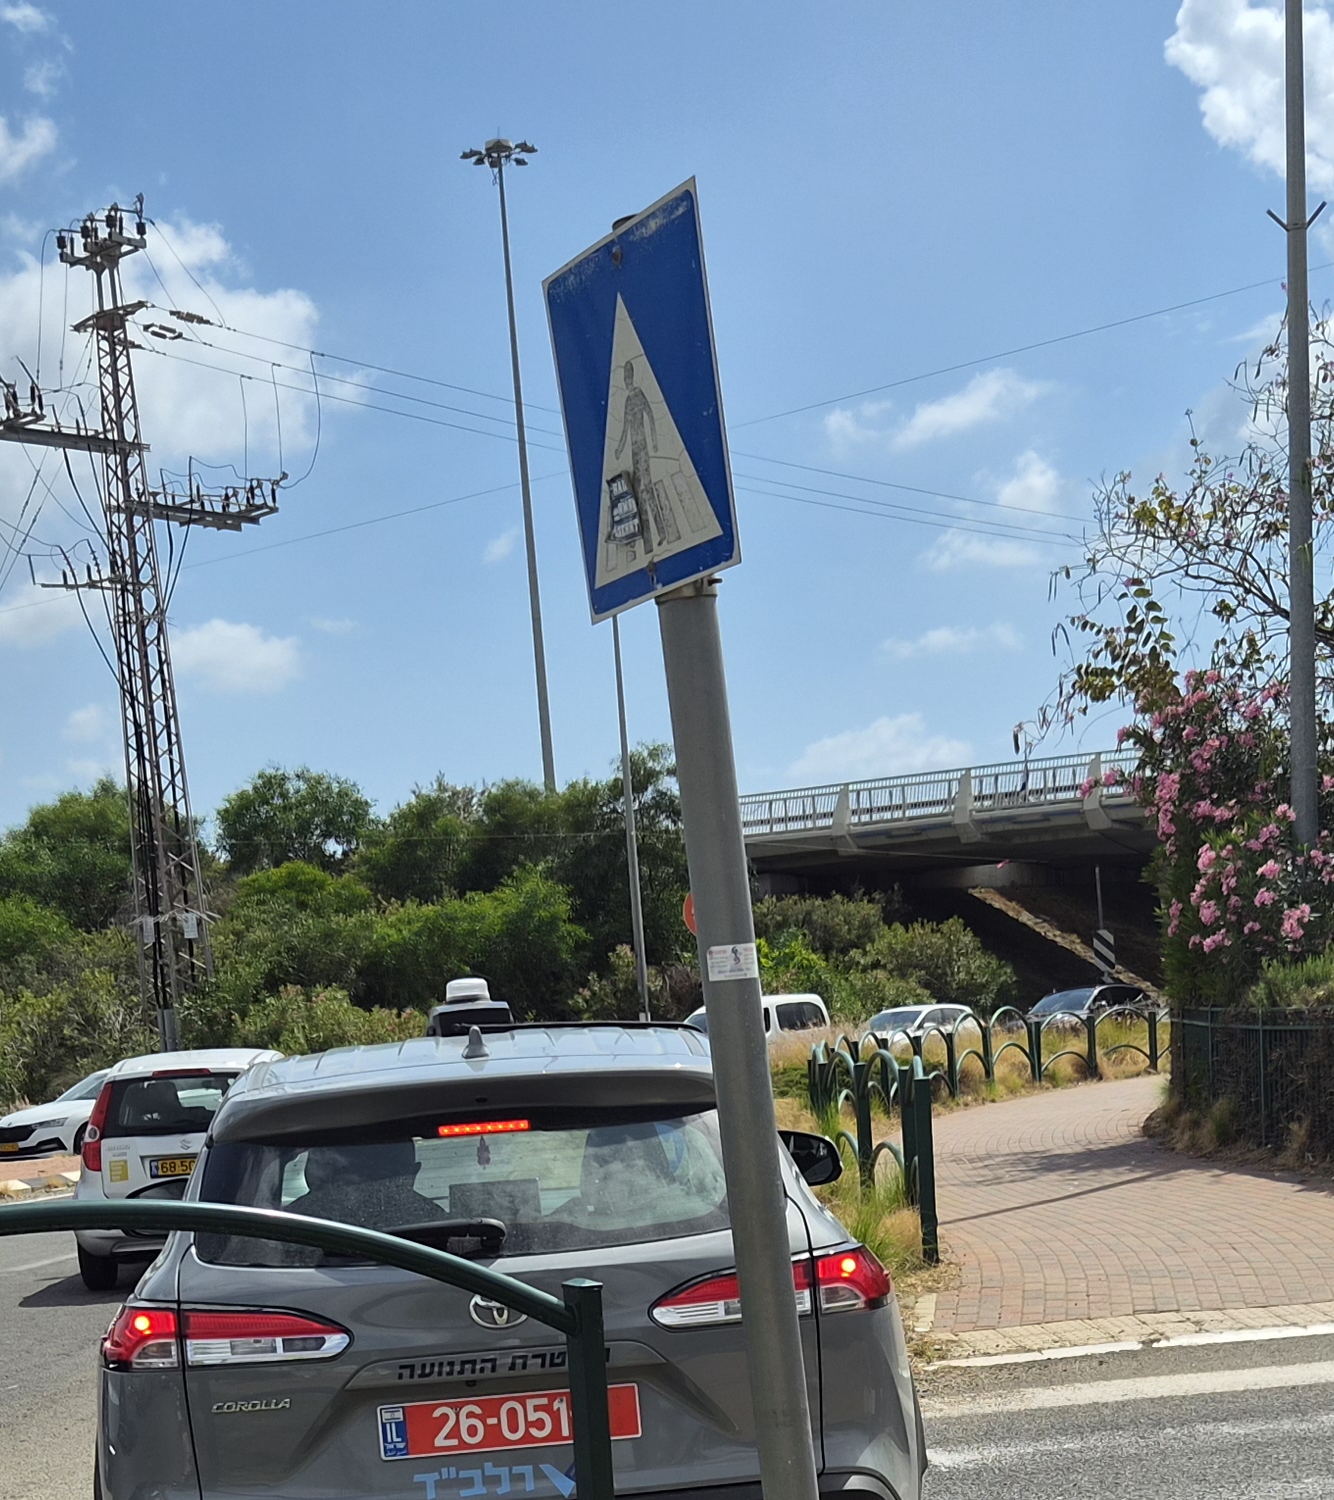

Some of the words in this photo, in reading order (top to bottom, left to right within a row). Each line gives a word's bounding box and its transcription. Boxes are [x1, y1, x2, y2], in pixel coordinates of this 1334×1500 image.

[397, 1357, 498, 1381] התנועה
[507, 1347, 610, 1373] טרת
[211, 1398, 292, 1413] COROLLA
[385, 1422, 403, 1443] IL
[431, 1396, 573, 1448] 26-051
